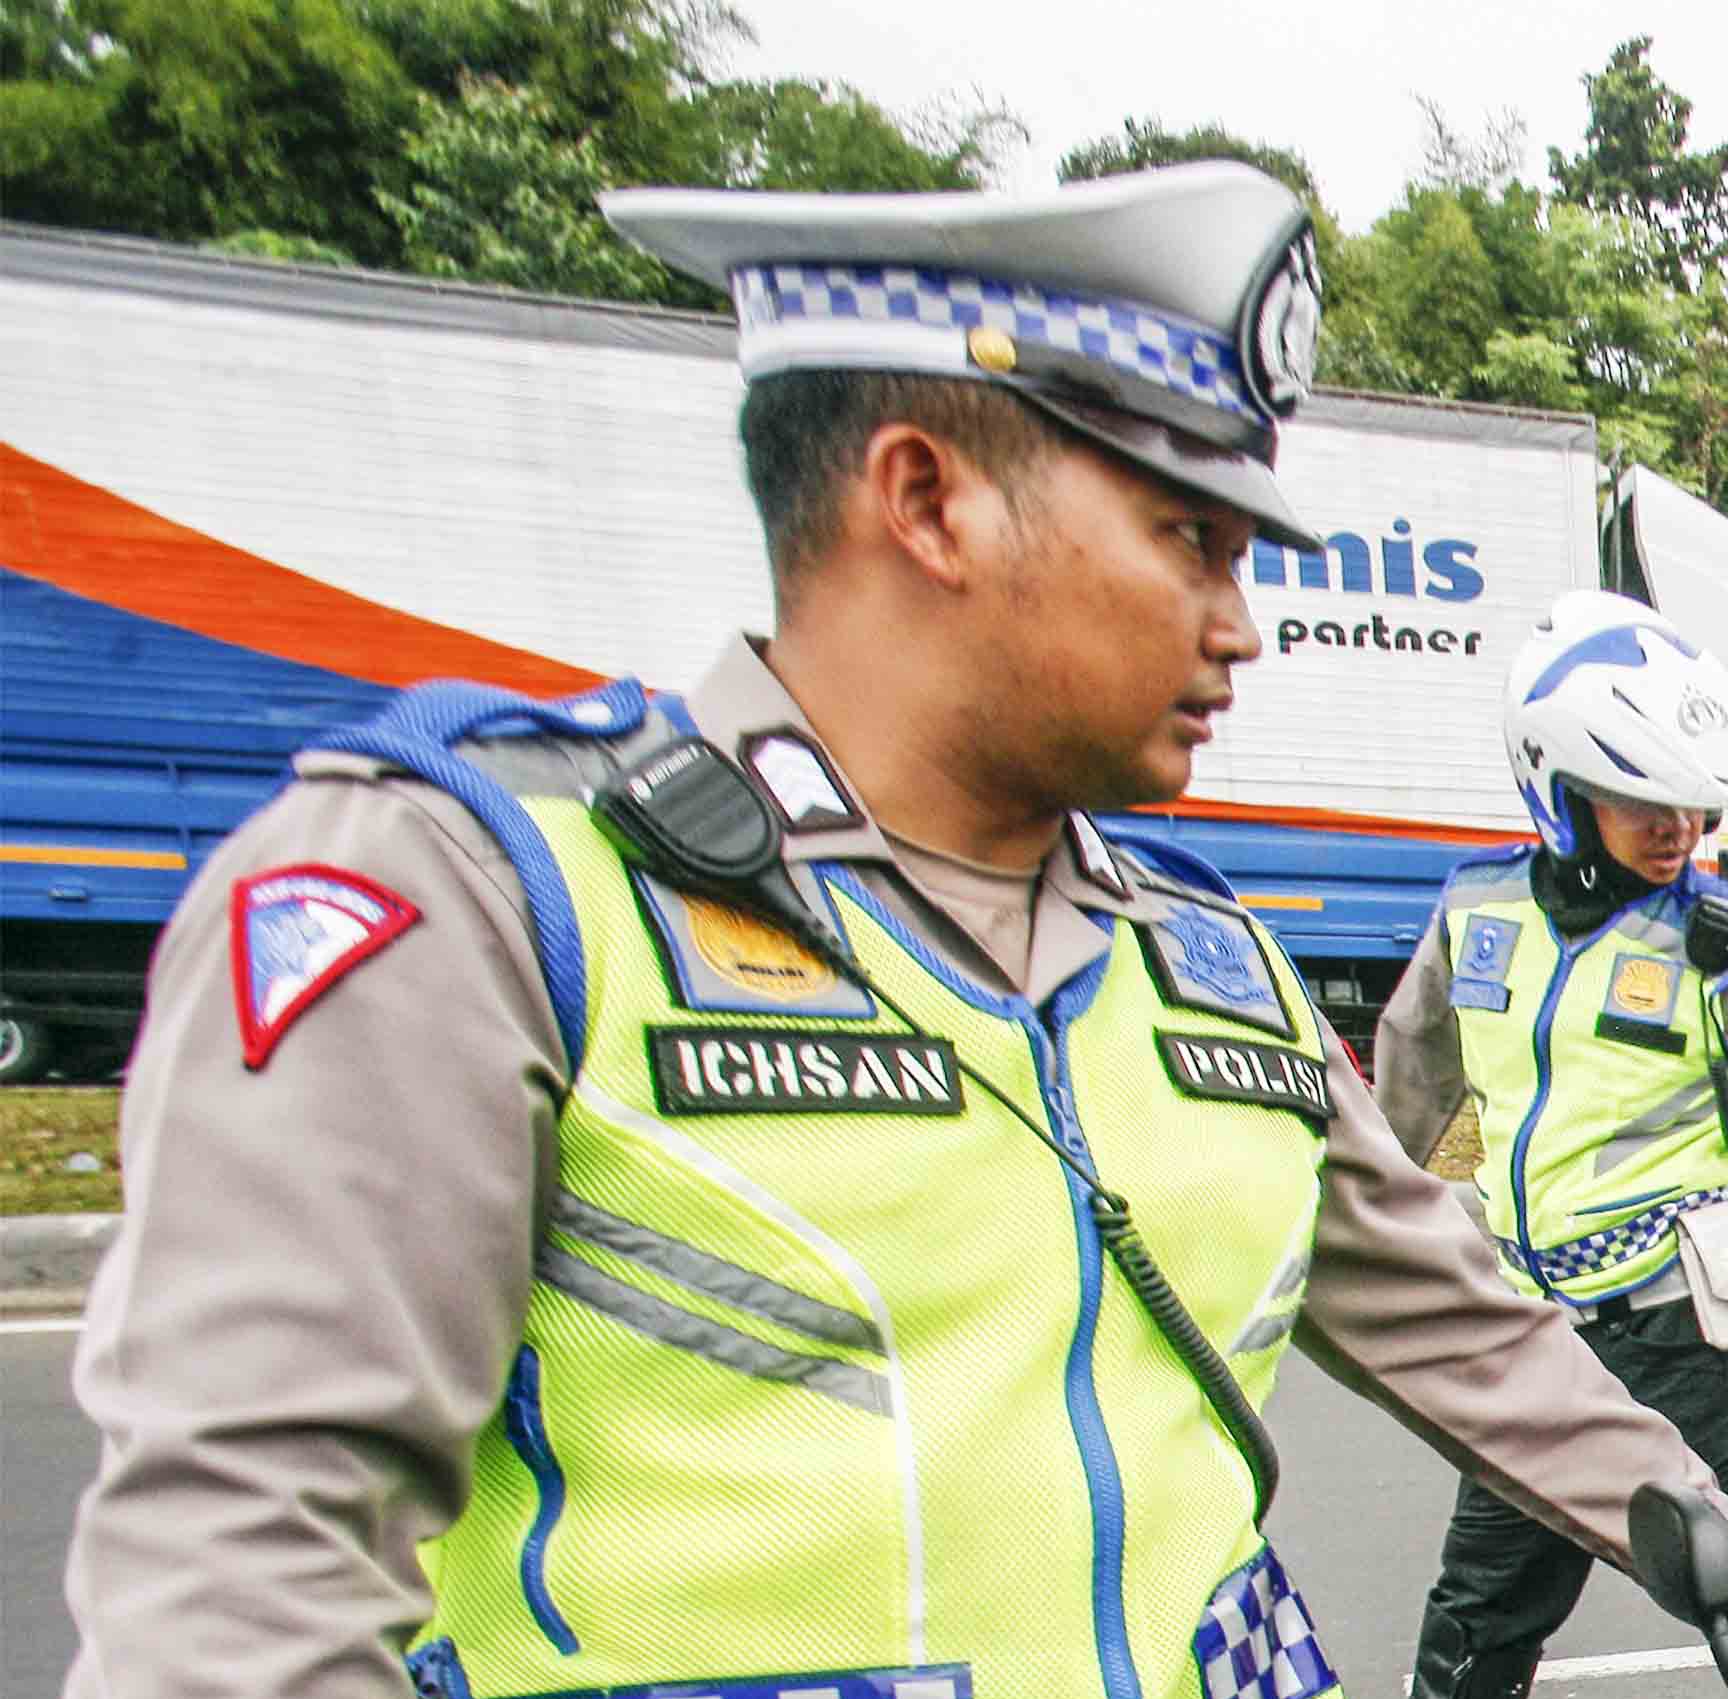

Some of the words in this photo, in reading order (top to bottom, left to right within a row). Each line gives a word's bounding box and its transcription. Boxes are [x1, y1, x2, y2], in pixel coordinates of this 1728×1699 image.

[1251, 516, 1485, 602] mis
[1277, 612, 1482, 655] partner
[676, 1039, 952, 1101] ICHSAN
[1172, 1040, 1329, 1109] POLISI
